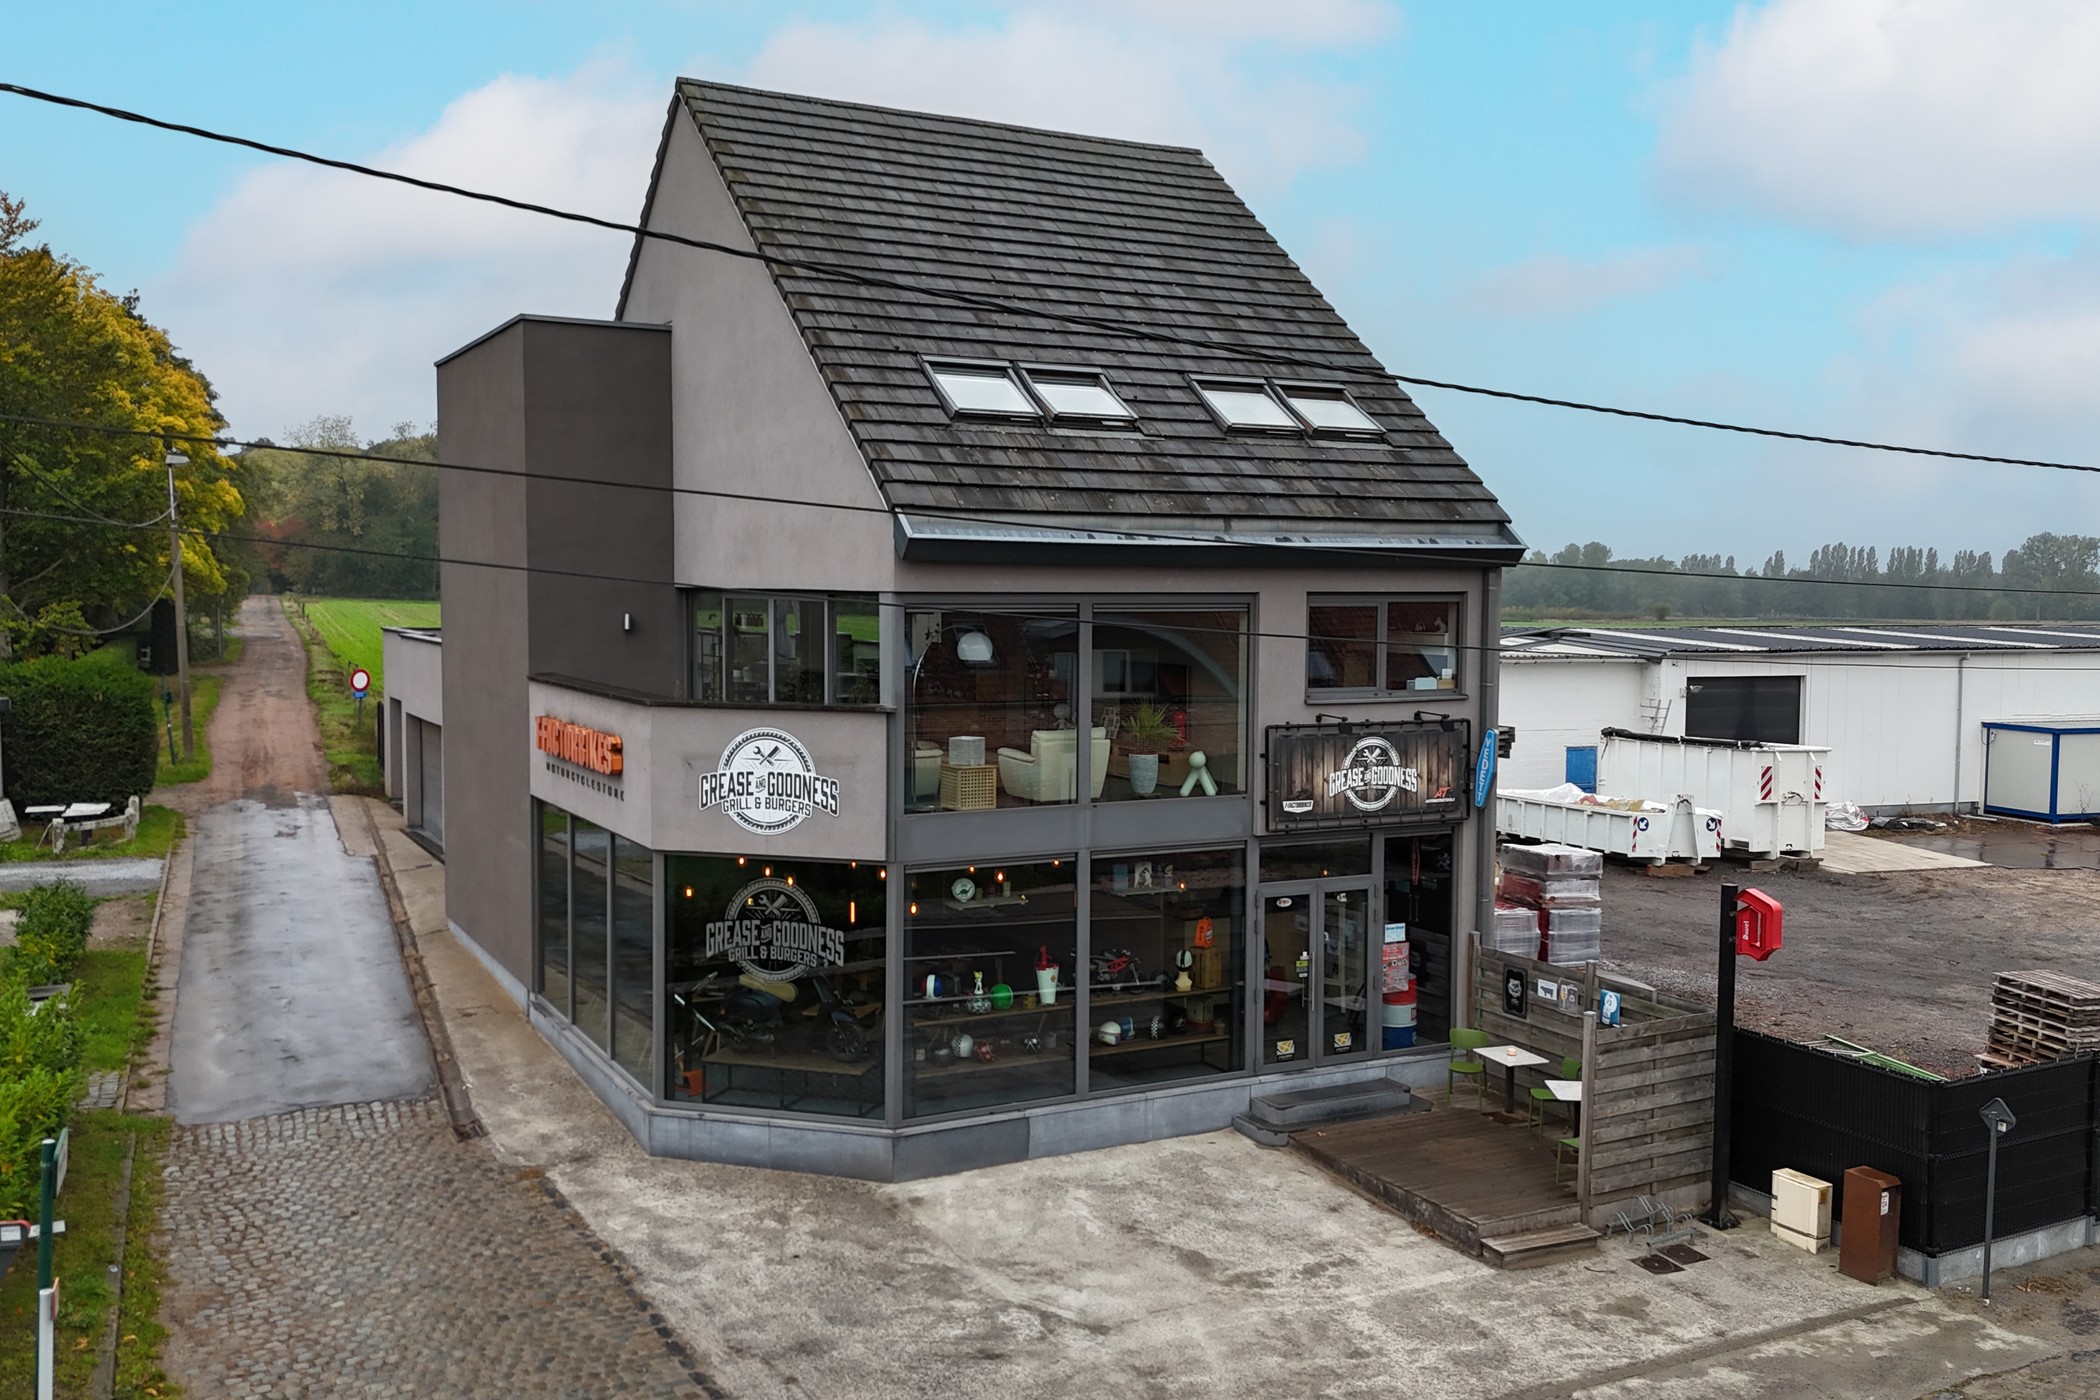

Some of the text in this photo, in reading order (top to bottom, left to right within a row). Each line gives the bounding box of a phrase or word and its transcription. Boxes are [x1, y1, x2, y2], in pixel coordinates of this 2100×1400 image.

[546, 761, 625, 802] MOTORCYCLESTORE
[1329, 765, 1418, 798] GREASE GOODNESS
[1477, 738, 1492, 802] VEDETT
[700, 771, 754, 809] GREASE
[767, 771, 839, 816] GOODNESS
[723, 797, 812, 817] GRILL & BURGERS
[706, 919, 760, 959] GREASE
[772, 920, 844, 968] GOODNESS
[728, 945, 818, 968] GRILL & BURGERS
